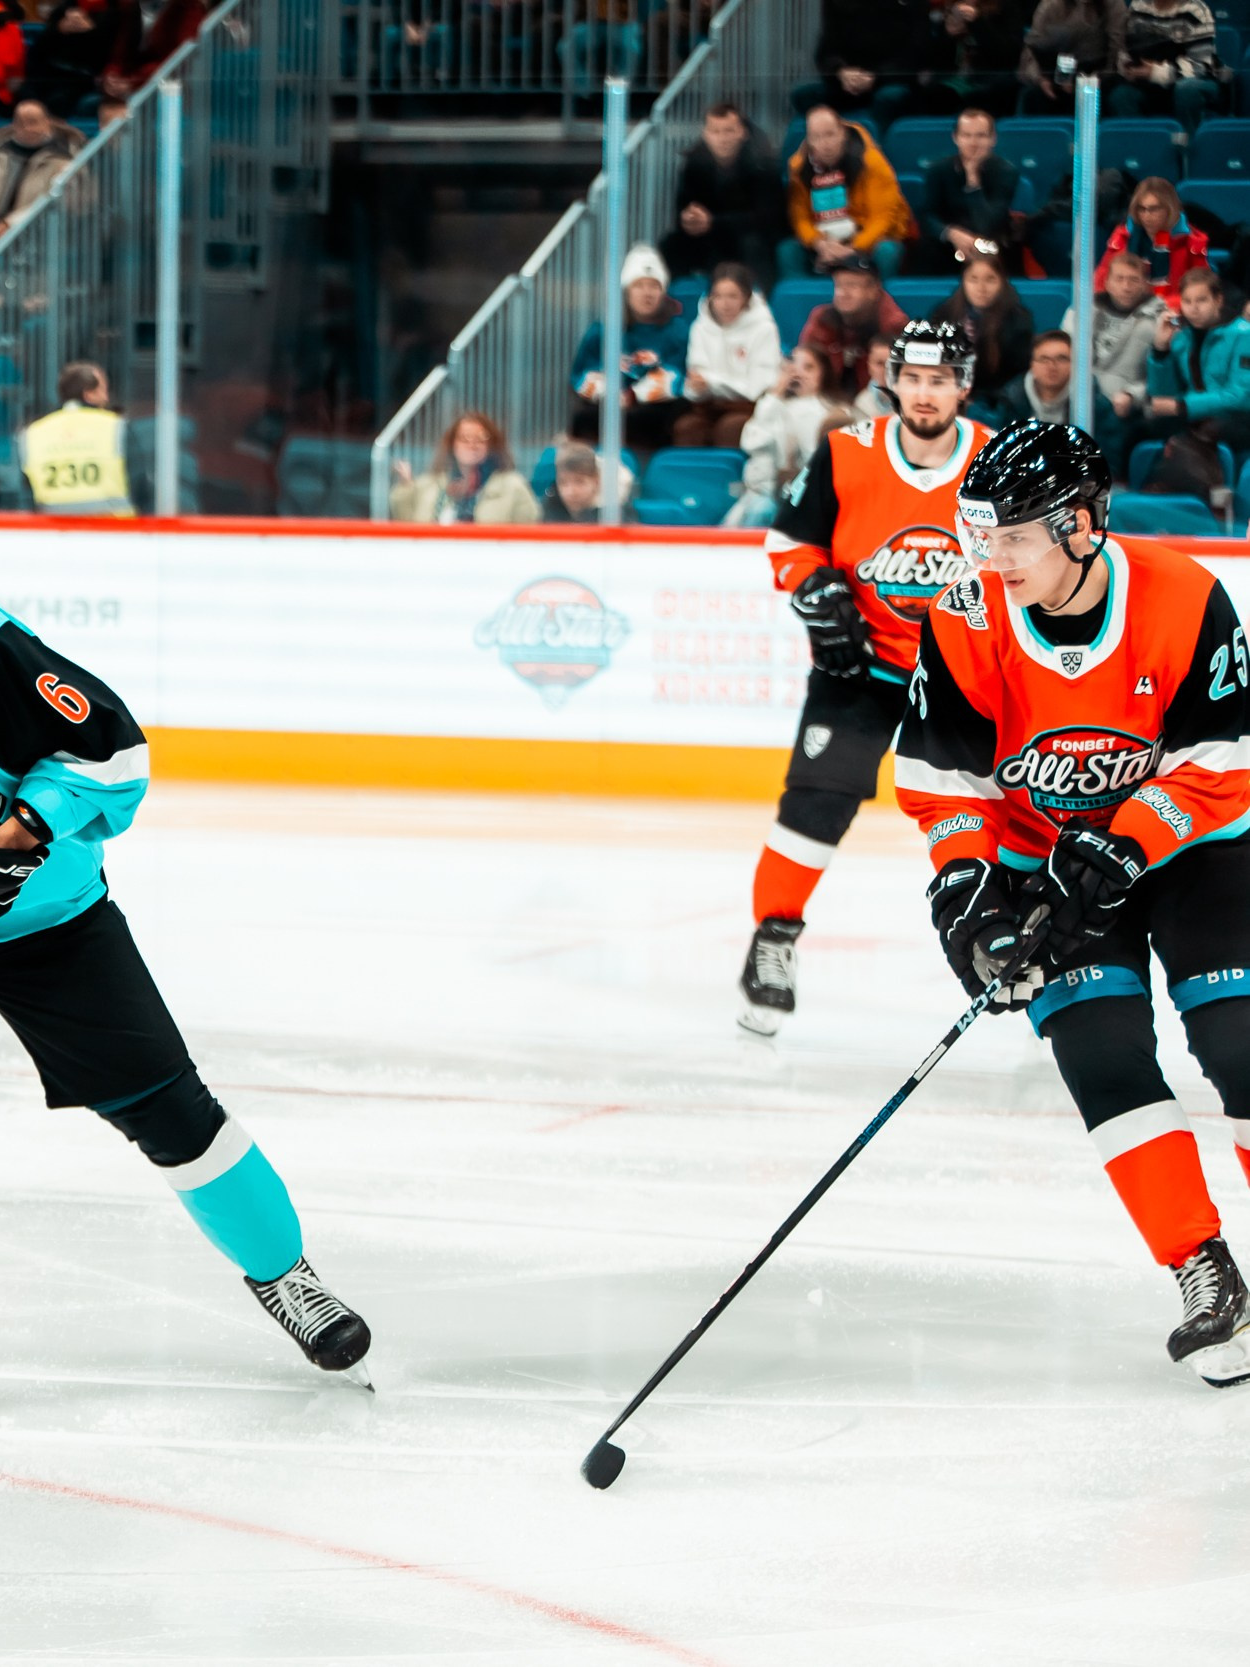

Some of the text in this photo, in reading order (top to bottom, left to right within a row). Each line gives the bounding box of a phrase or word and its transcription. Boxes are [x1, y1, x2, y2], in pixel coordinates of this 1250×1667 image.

[44, 462, 100, 488] 230
[1048, 486, 1080, 509] TRUE
[857, 548, 968, 586] All-Sta
[1208, 625, 1249, 701] 25
[35, 672, 91, 725] 6
[1052, 737, 1117, 752] FONBET
[1065, 964, 1104, 987] ВТБ
[956, 977, 1002, 1034] CCM
[858, 1091, 905, 1145] RIBCOR
